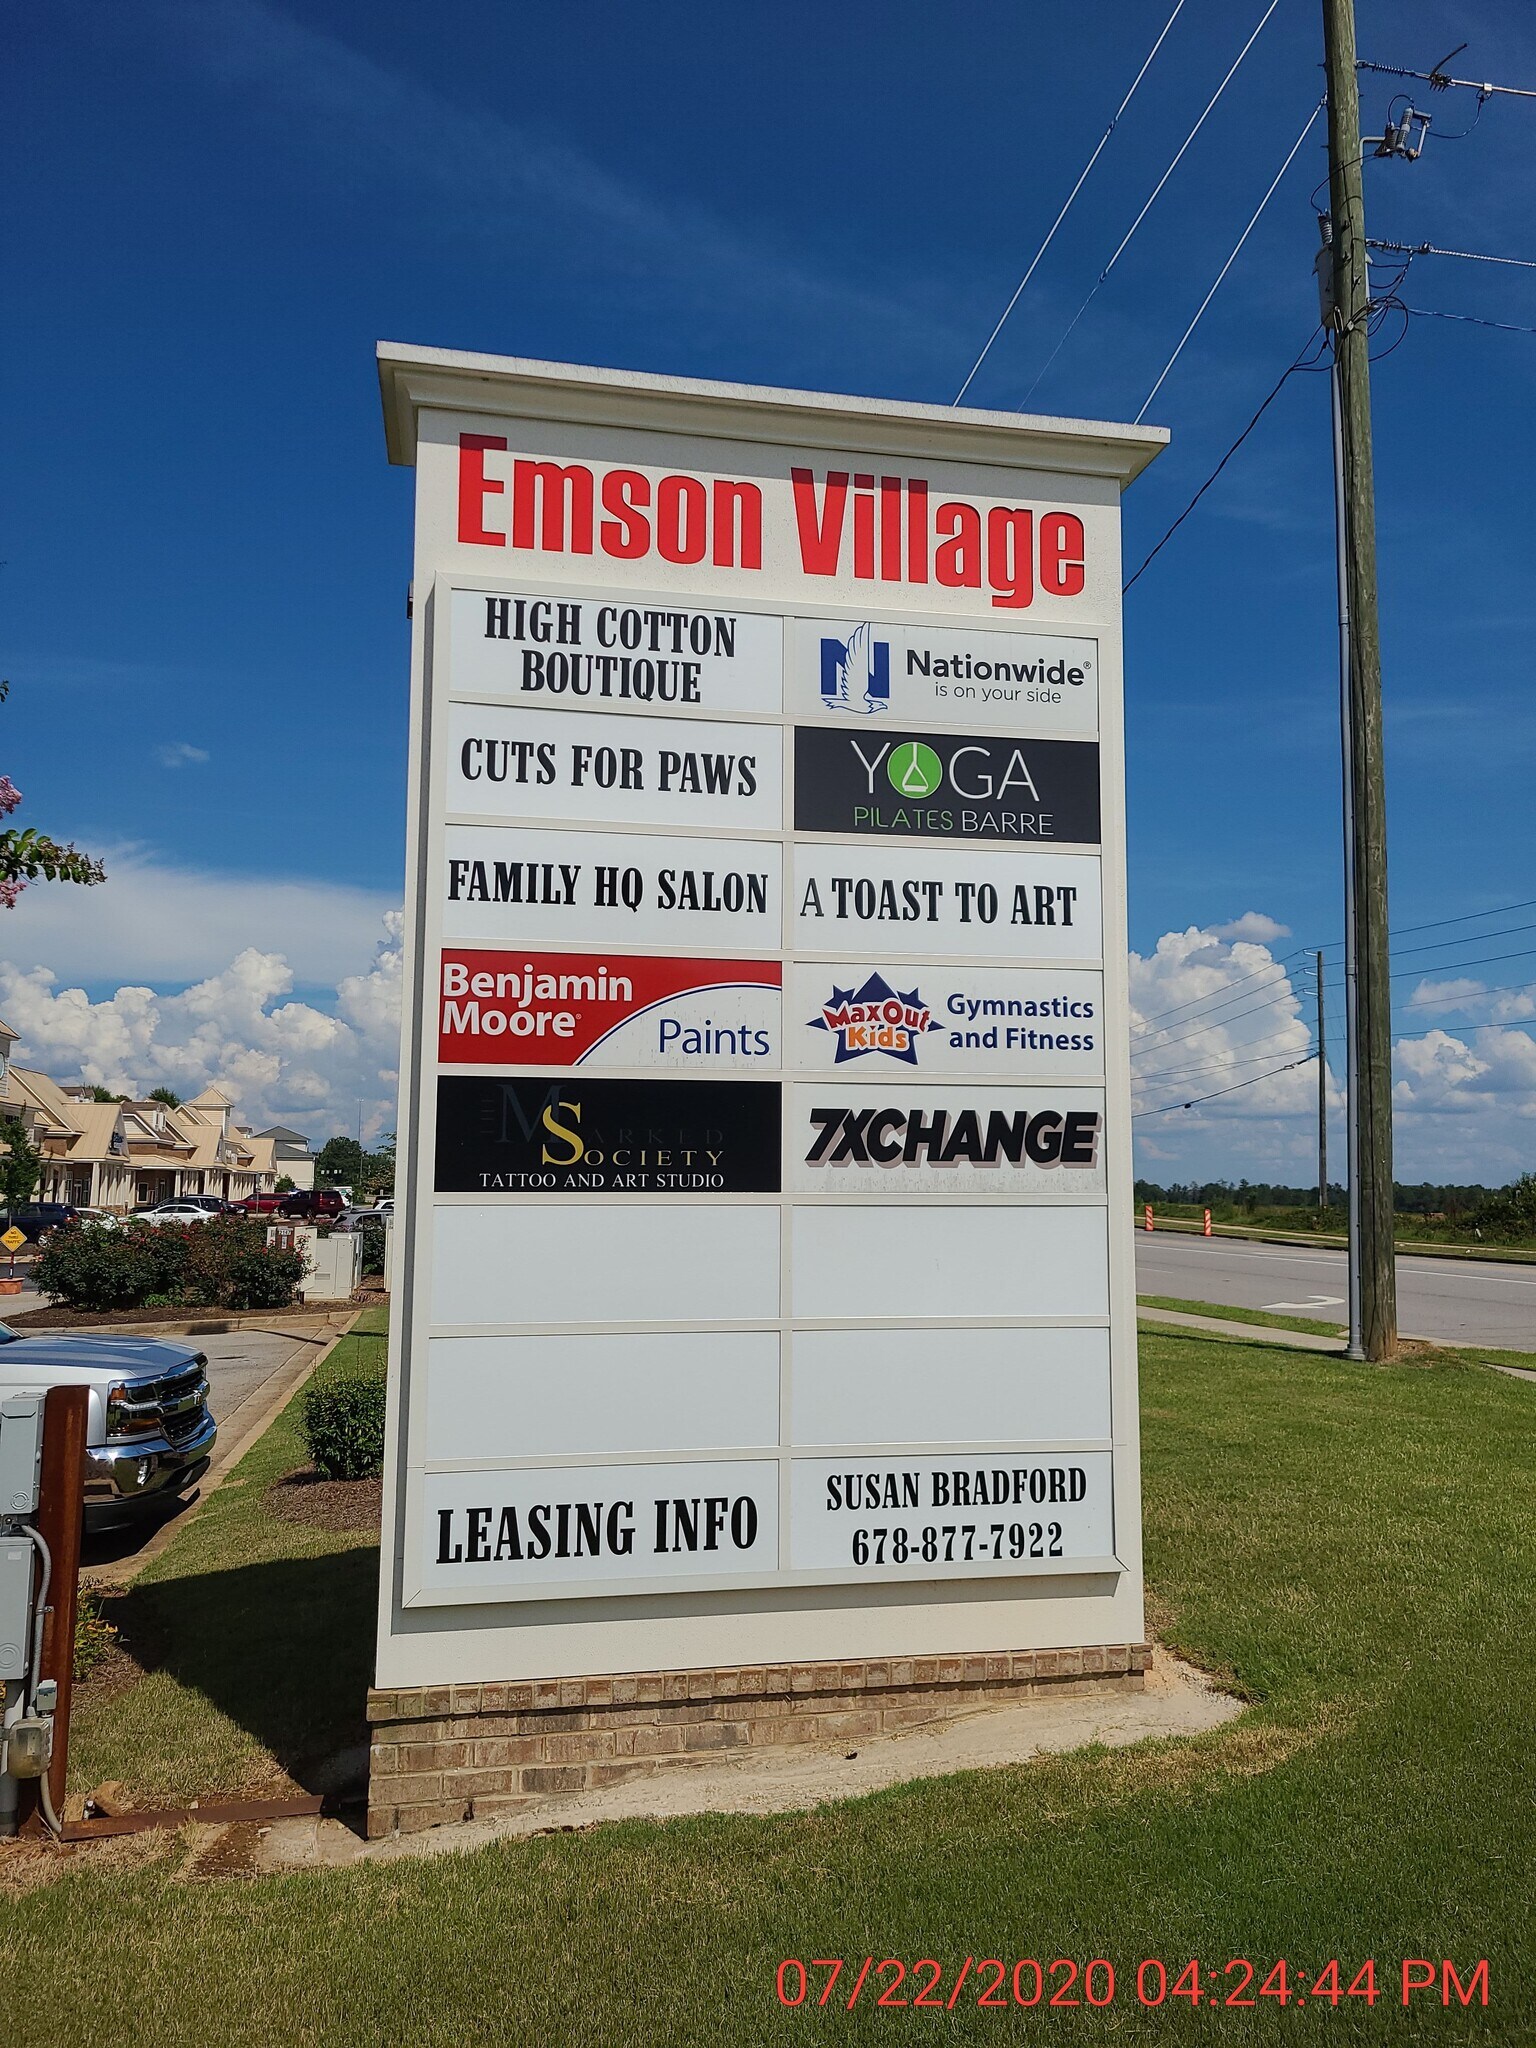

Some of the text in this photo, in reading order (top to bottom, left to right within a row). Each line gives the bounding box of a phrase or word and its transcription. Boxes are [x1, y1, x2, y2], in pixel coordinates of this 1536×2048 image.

[458, 432, 1085, 609] Emson Village
[484, 597, 736, 658] HIGH COTTON
[520, 649, 701, 702] BOUTIQUE
[935, 682, 1062, 704] is on your side
[461, 738, 757, 796] CUTS FOR PAWS
[854, 807, 1054, 836] PILATES BARRE
[448, 860, 768, 914] FAMILY HQ SALON
[800, 877, 1077, 926] A TOAST TO ART
[443, 963, 632, 1008] Benjamin
[946, 993, 1094, 1021] Gymnastics
[659, 1019, 770, 1056] Paints
[848, 1026, 907, 1050] Kids
[949, 1026, 1094, 1051] and Fitness
[804, 1107, 1101, 1167] 7XCHANGE
[479, 1173, 724, 1188] TATTOO AND ART STUDIO
[826, 1467, 1087, 1511] SUSAN BRADFORD
[436, 1495, 758, 1564] LEASING INFO
[852, 1521, 1063, 1565] 678-877-7922
